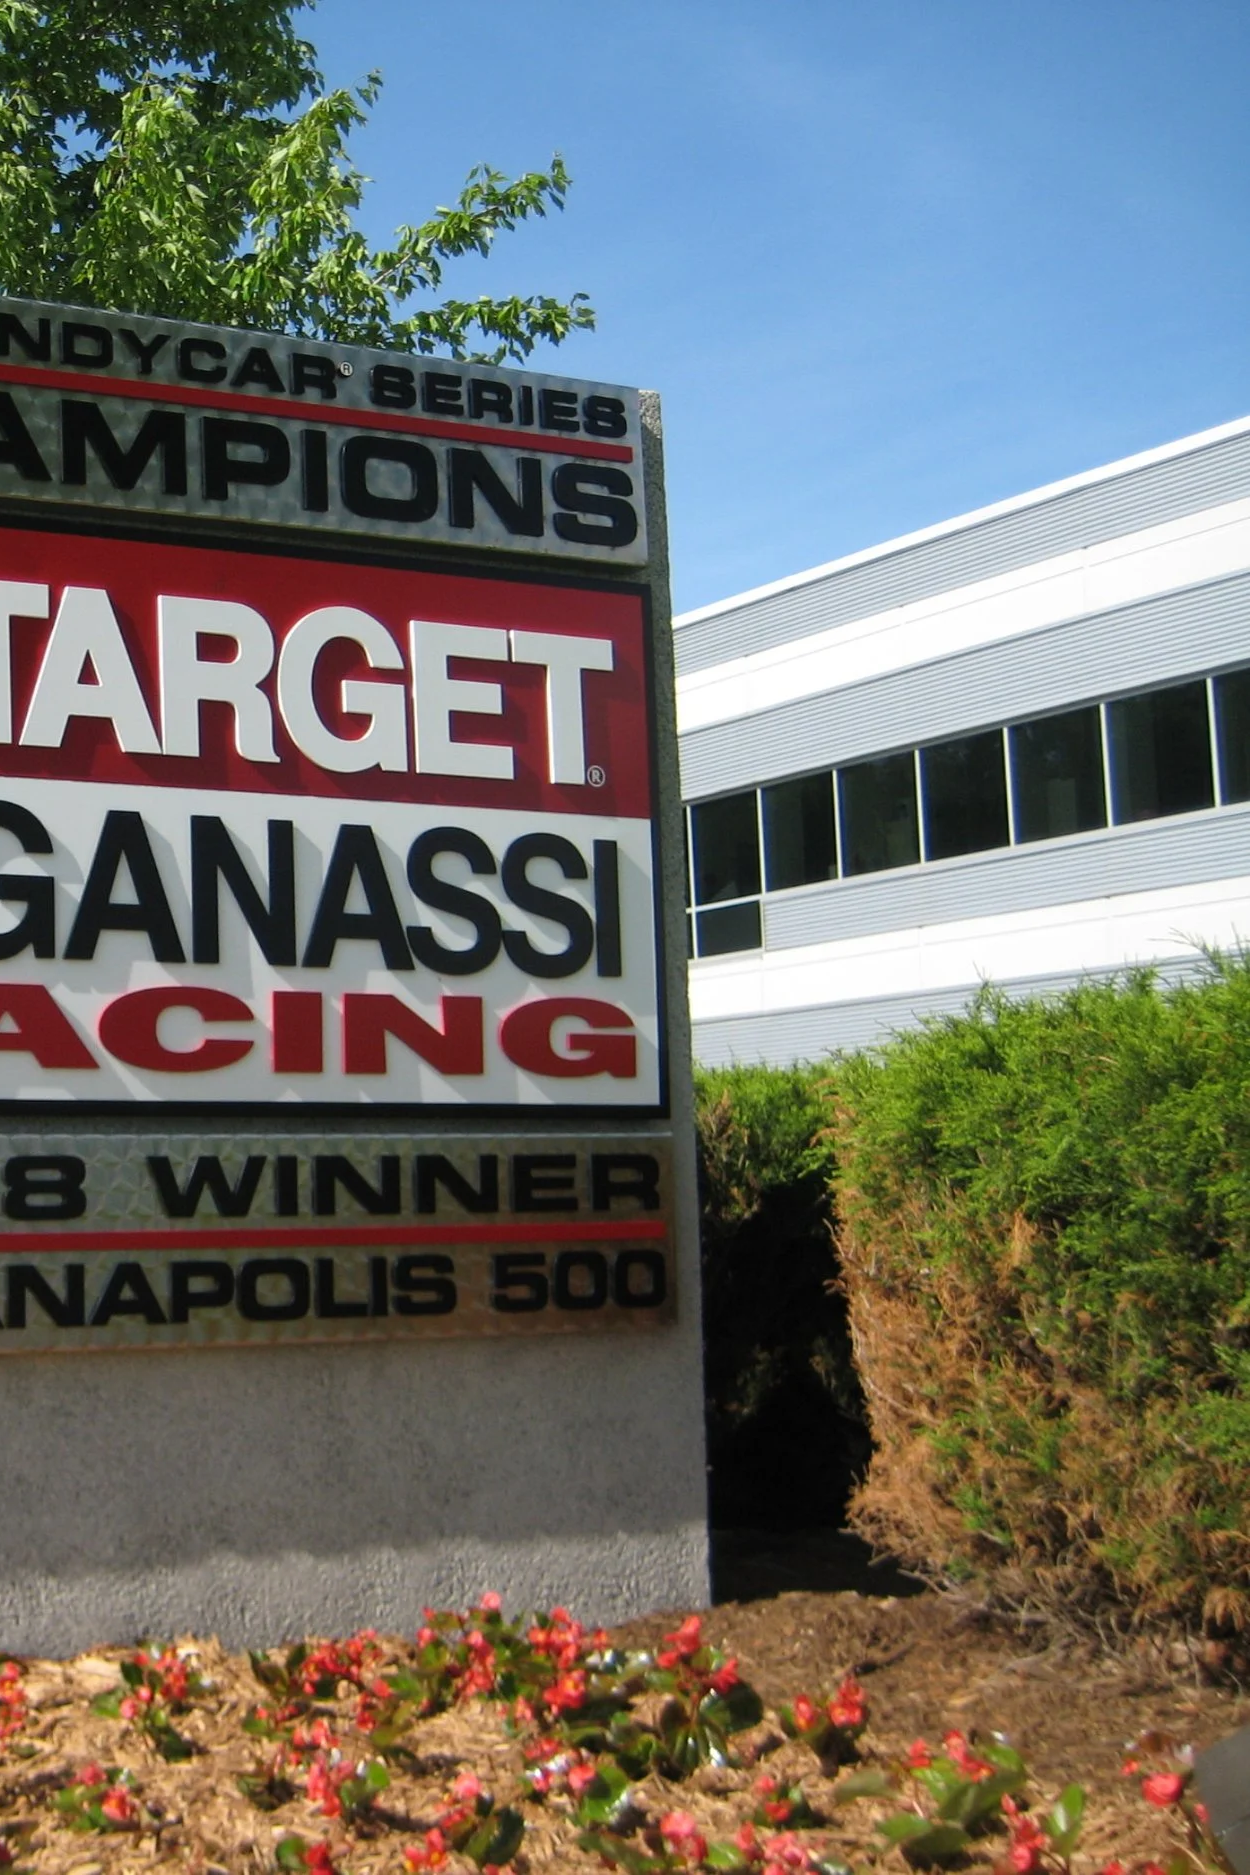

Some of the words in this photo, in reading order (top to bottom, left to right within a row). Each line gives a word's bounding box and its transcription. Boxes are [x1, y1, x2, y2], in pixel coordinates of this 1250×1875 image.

[369, 364, 628, 438] SERIES
[146, 1152, 660, 1217] WINNER
[491, 1248, 667, 1314] 500
